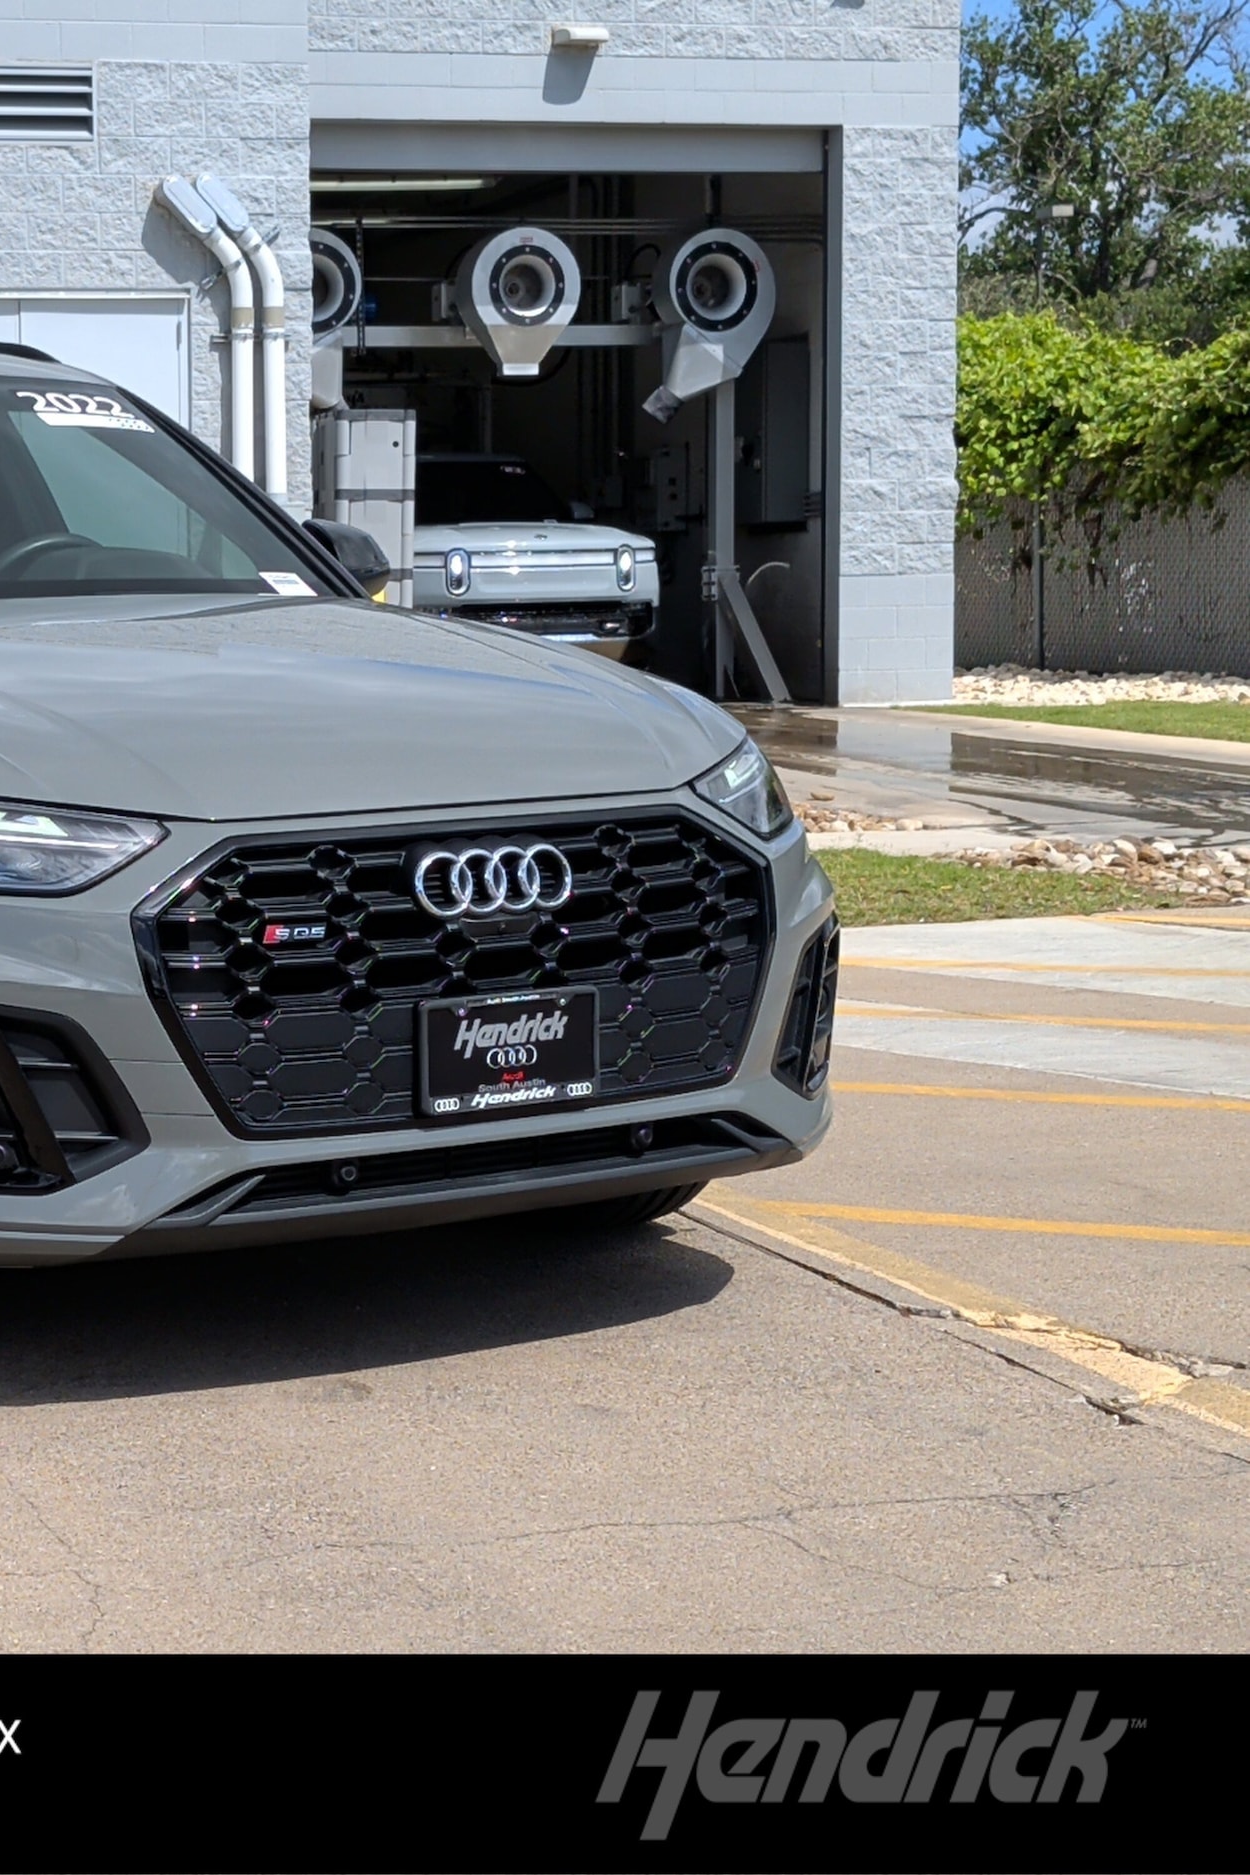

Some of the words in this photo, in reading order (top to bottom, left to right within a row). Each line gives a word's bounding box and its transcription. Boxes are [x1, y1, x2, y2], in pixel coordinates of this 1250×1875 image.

[16, 391, 135, 419] 2022
[273, 926, 326, 941] SQ5
[453, 1010, 569, 1060] Hendrick
[470, 1085, 557, 1109] Hendrick
[478, 1081, 511, 1093] South
[512, 1078, 547, 1090] Austin
